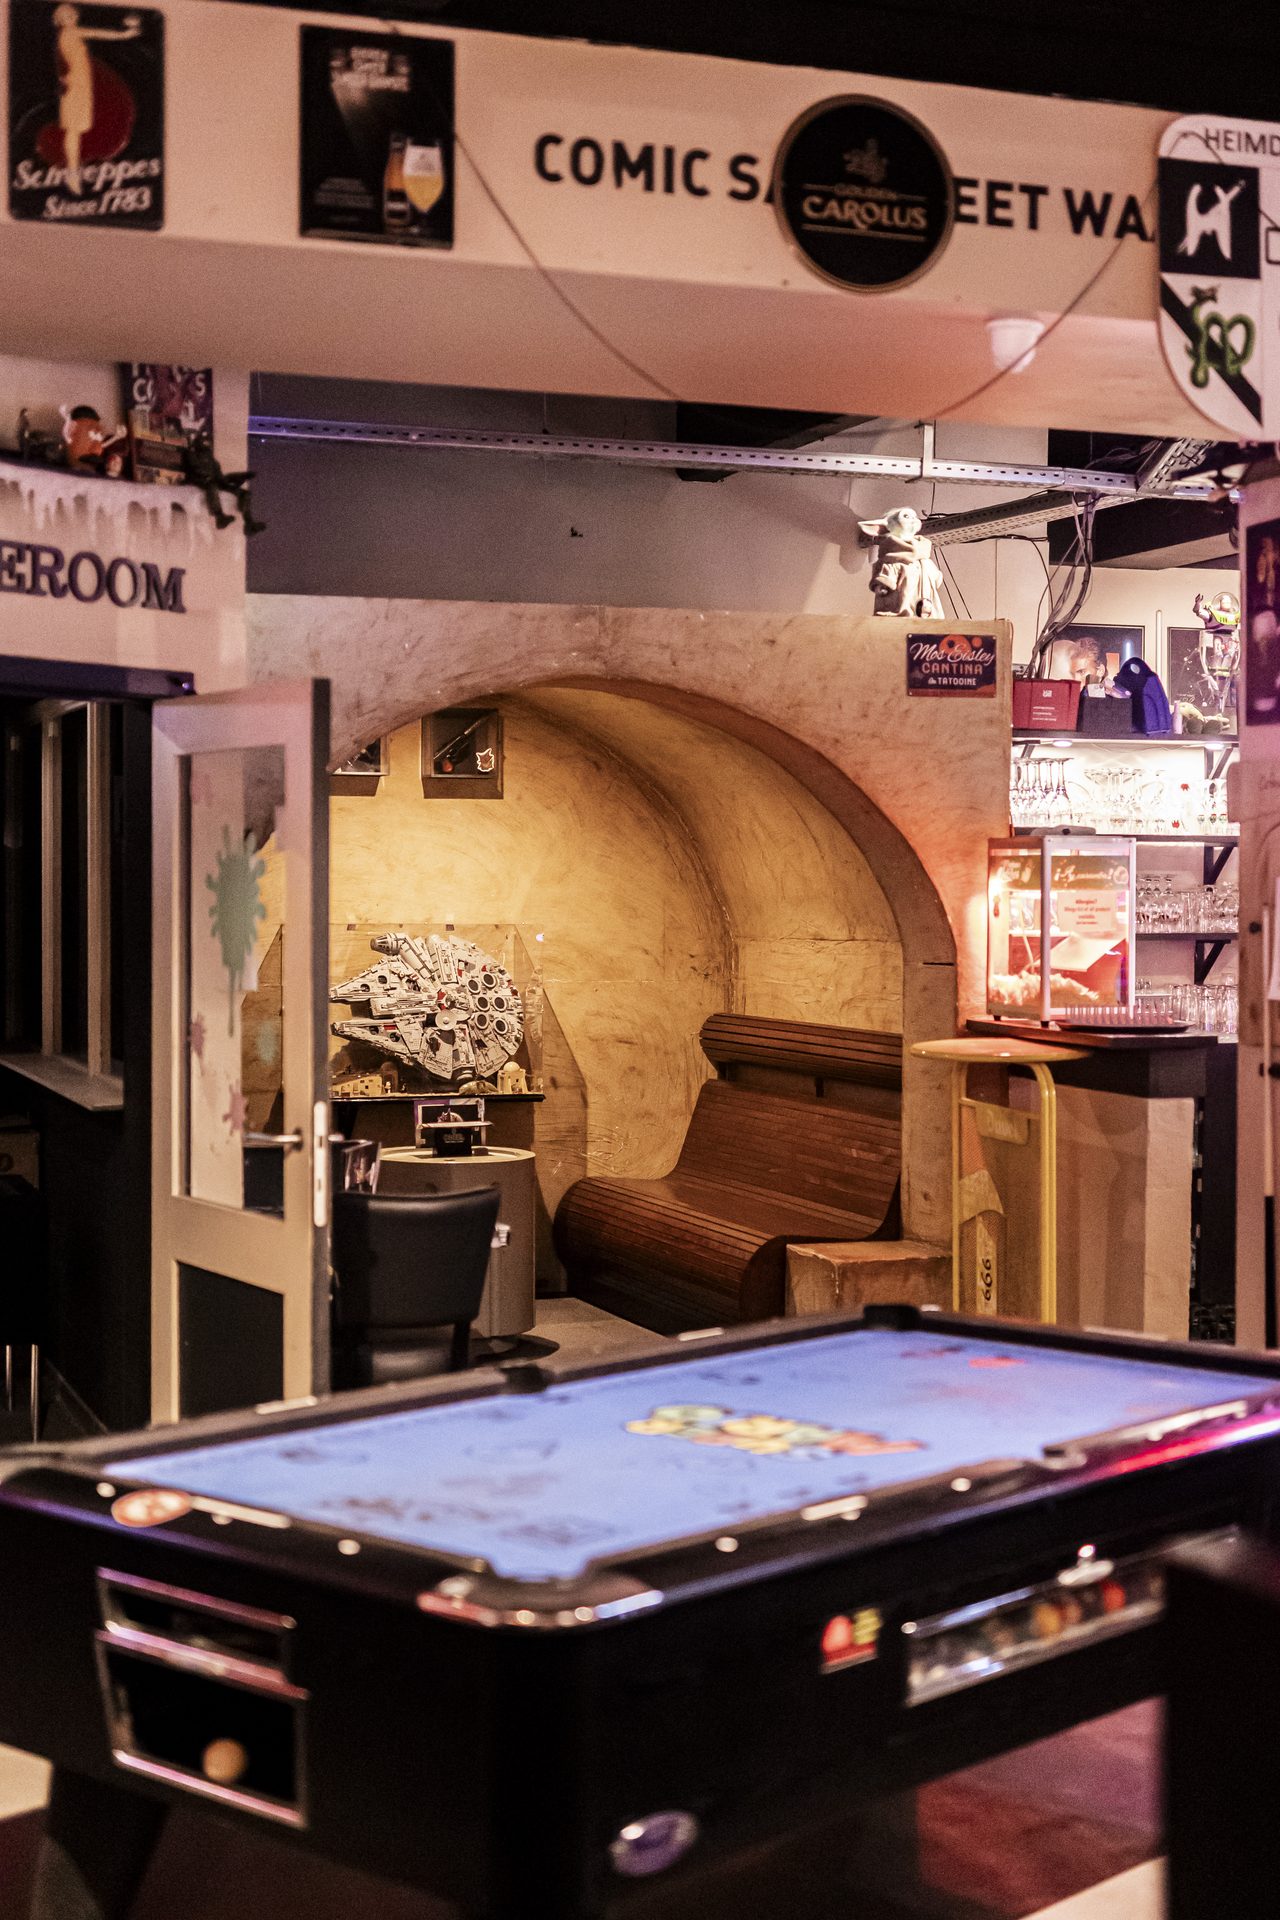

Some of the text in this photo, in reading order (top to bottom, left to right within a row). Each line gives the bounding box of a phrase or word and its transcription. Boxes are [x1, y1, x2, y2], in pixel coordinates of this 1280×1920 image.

[533, 134, 773, 205] COMIC S
[802, 195, 928, 232] CAROLUS
[909, 642, 996, 667] Mos Eisley
[921, 662, 983, 675] CANTINA
[937, 677, 977, 686] TATOOINE
